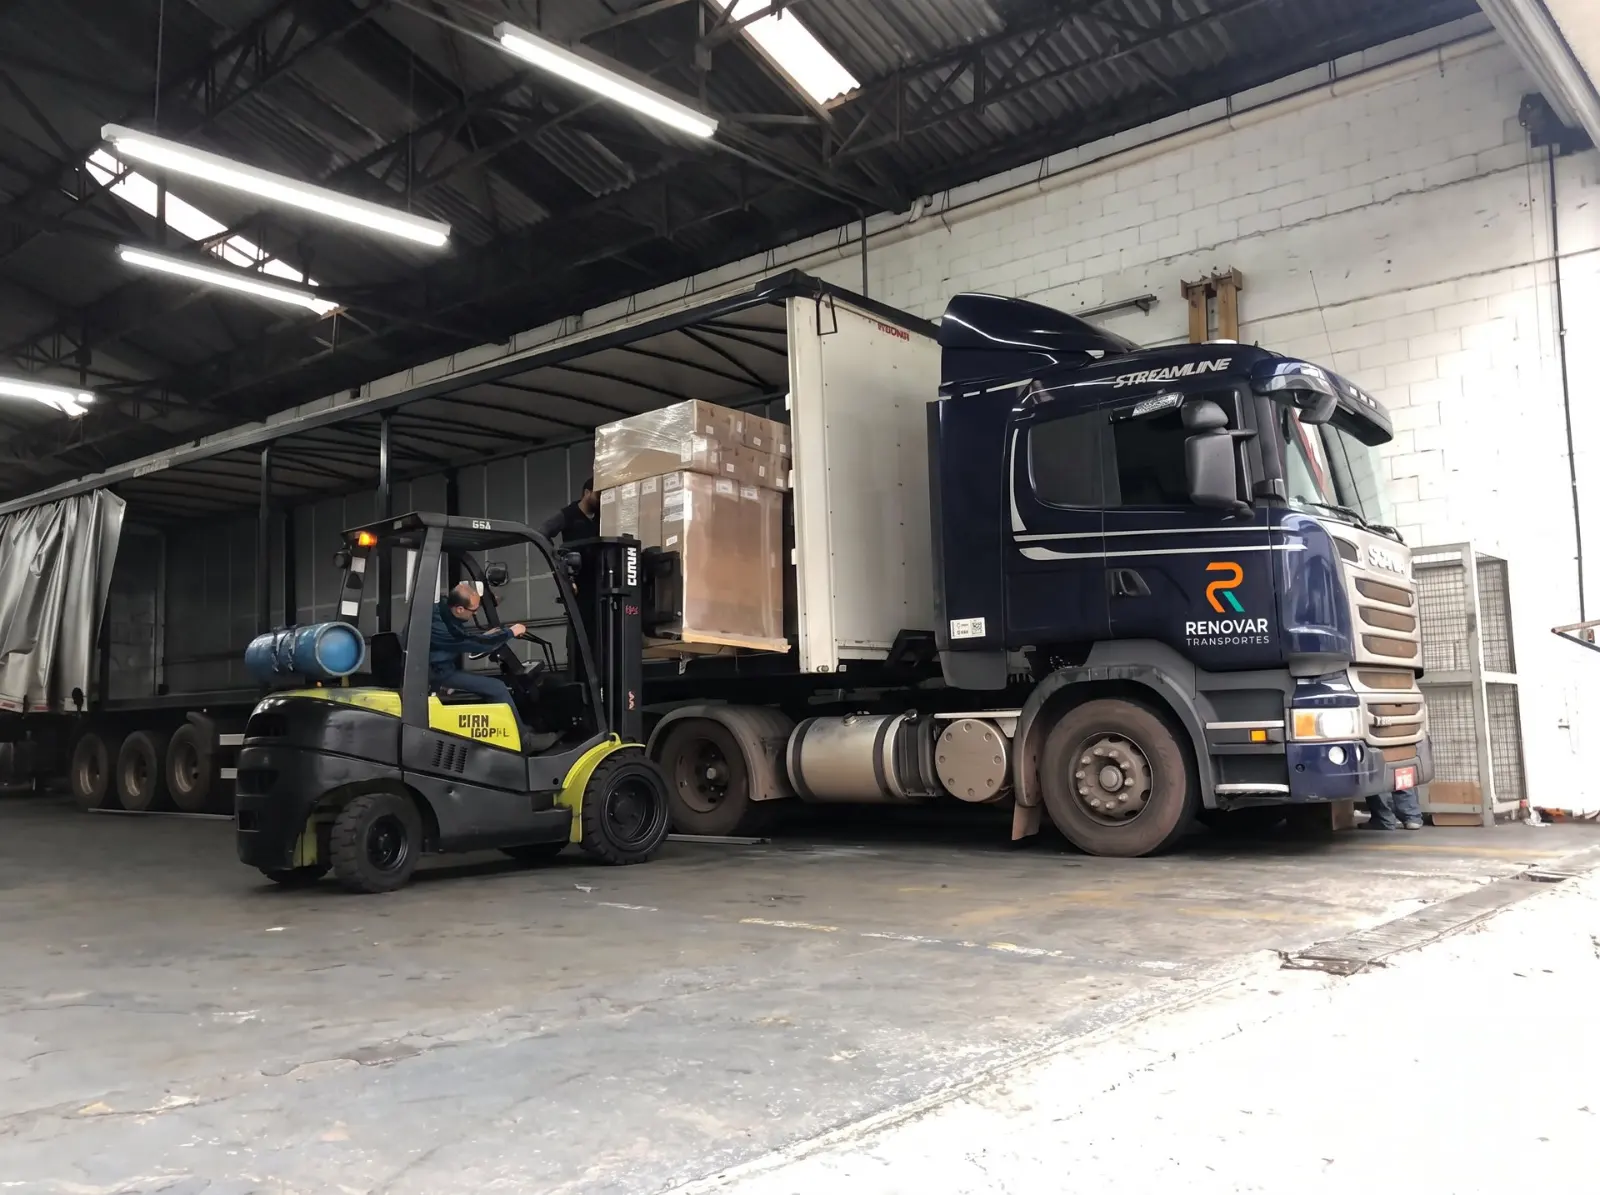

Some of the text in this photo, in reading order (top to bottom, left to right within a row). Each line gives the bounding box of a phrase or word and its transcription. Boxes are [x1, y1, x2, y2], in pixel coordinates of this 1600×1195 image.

[1113, 358, 1232, 388] STREAMLINE
[1185, 618, 1268, 635] RENOVAR
[1186, 635, 1270, 646] TRANSPORTES
